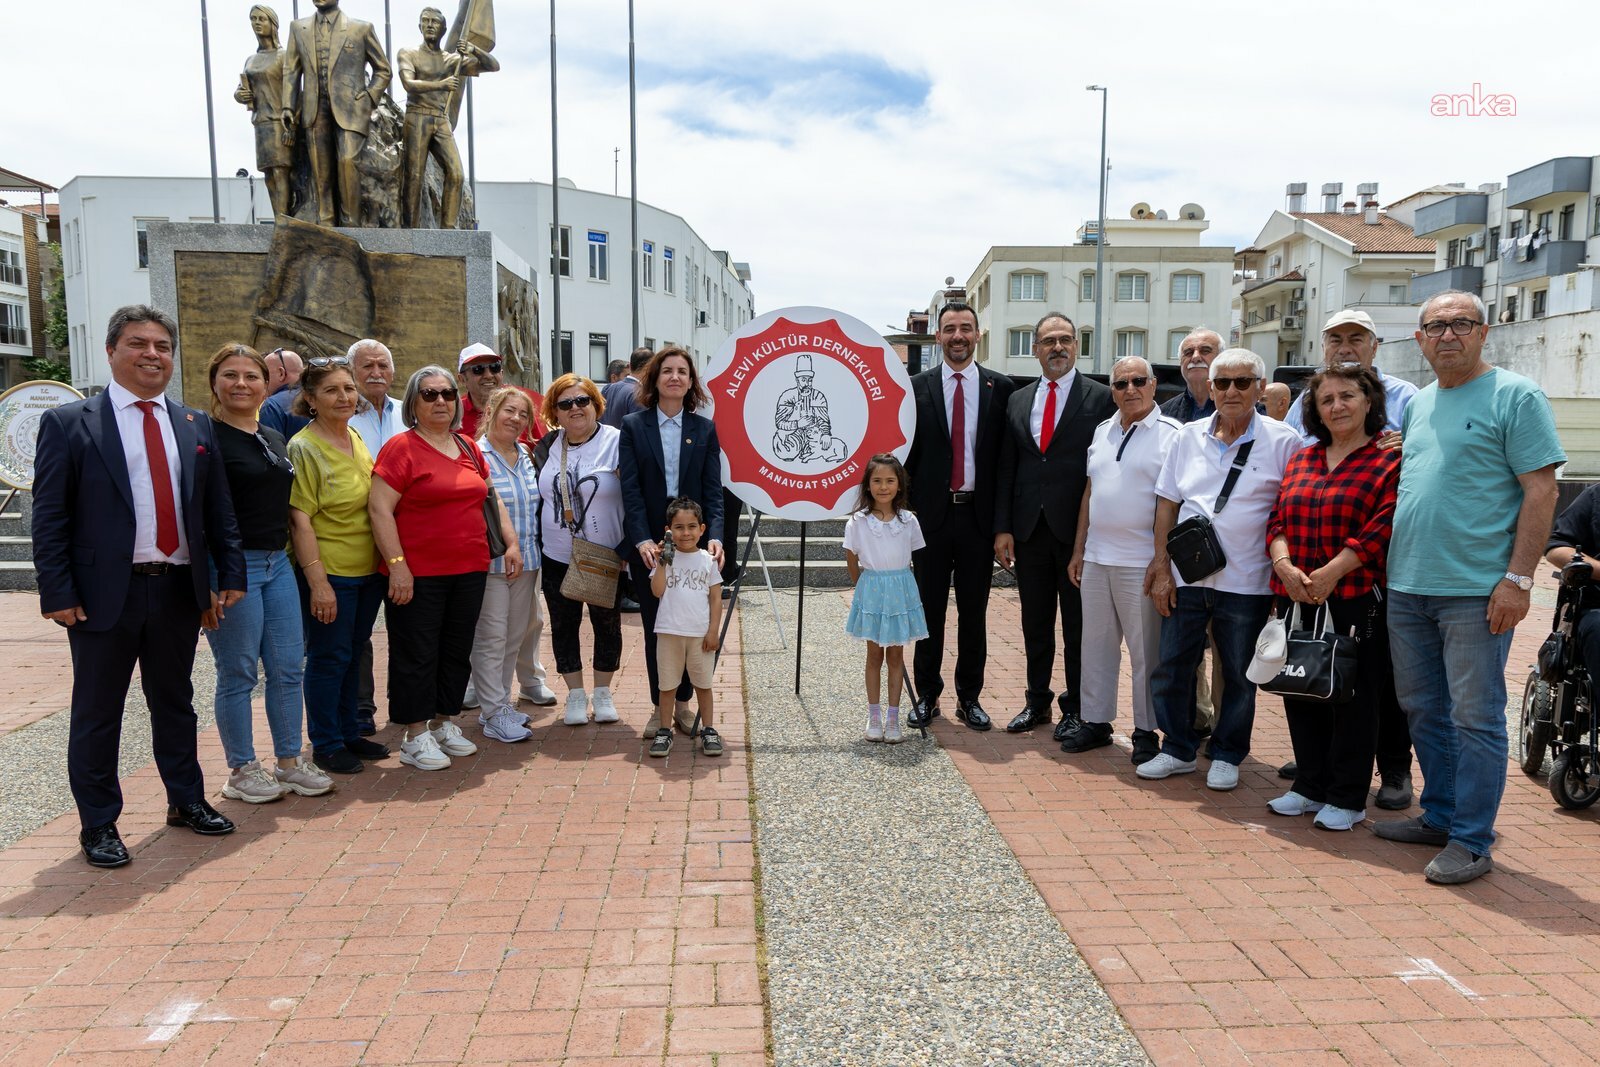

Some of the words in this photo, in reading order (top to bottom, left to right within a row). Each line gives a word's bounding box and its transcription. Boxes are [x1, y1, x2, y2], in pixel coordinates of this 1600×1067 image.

[726, 356, 754, 398] ALEVİ
[752, 334, 808, 361] KÜLTÜR
[812, 336, 885, 401] DERNEKLERİ
[758, 466, 818, 489] MANAVGAT
[820, 460, 859, 489] ŞUBESİ
[666, 575, 704, 590] GRASS
[1278, 664, 1306, 678] FILA
